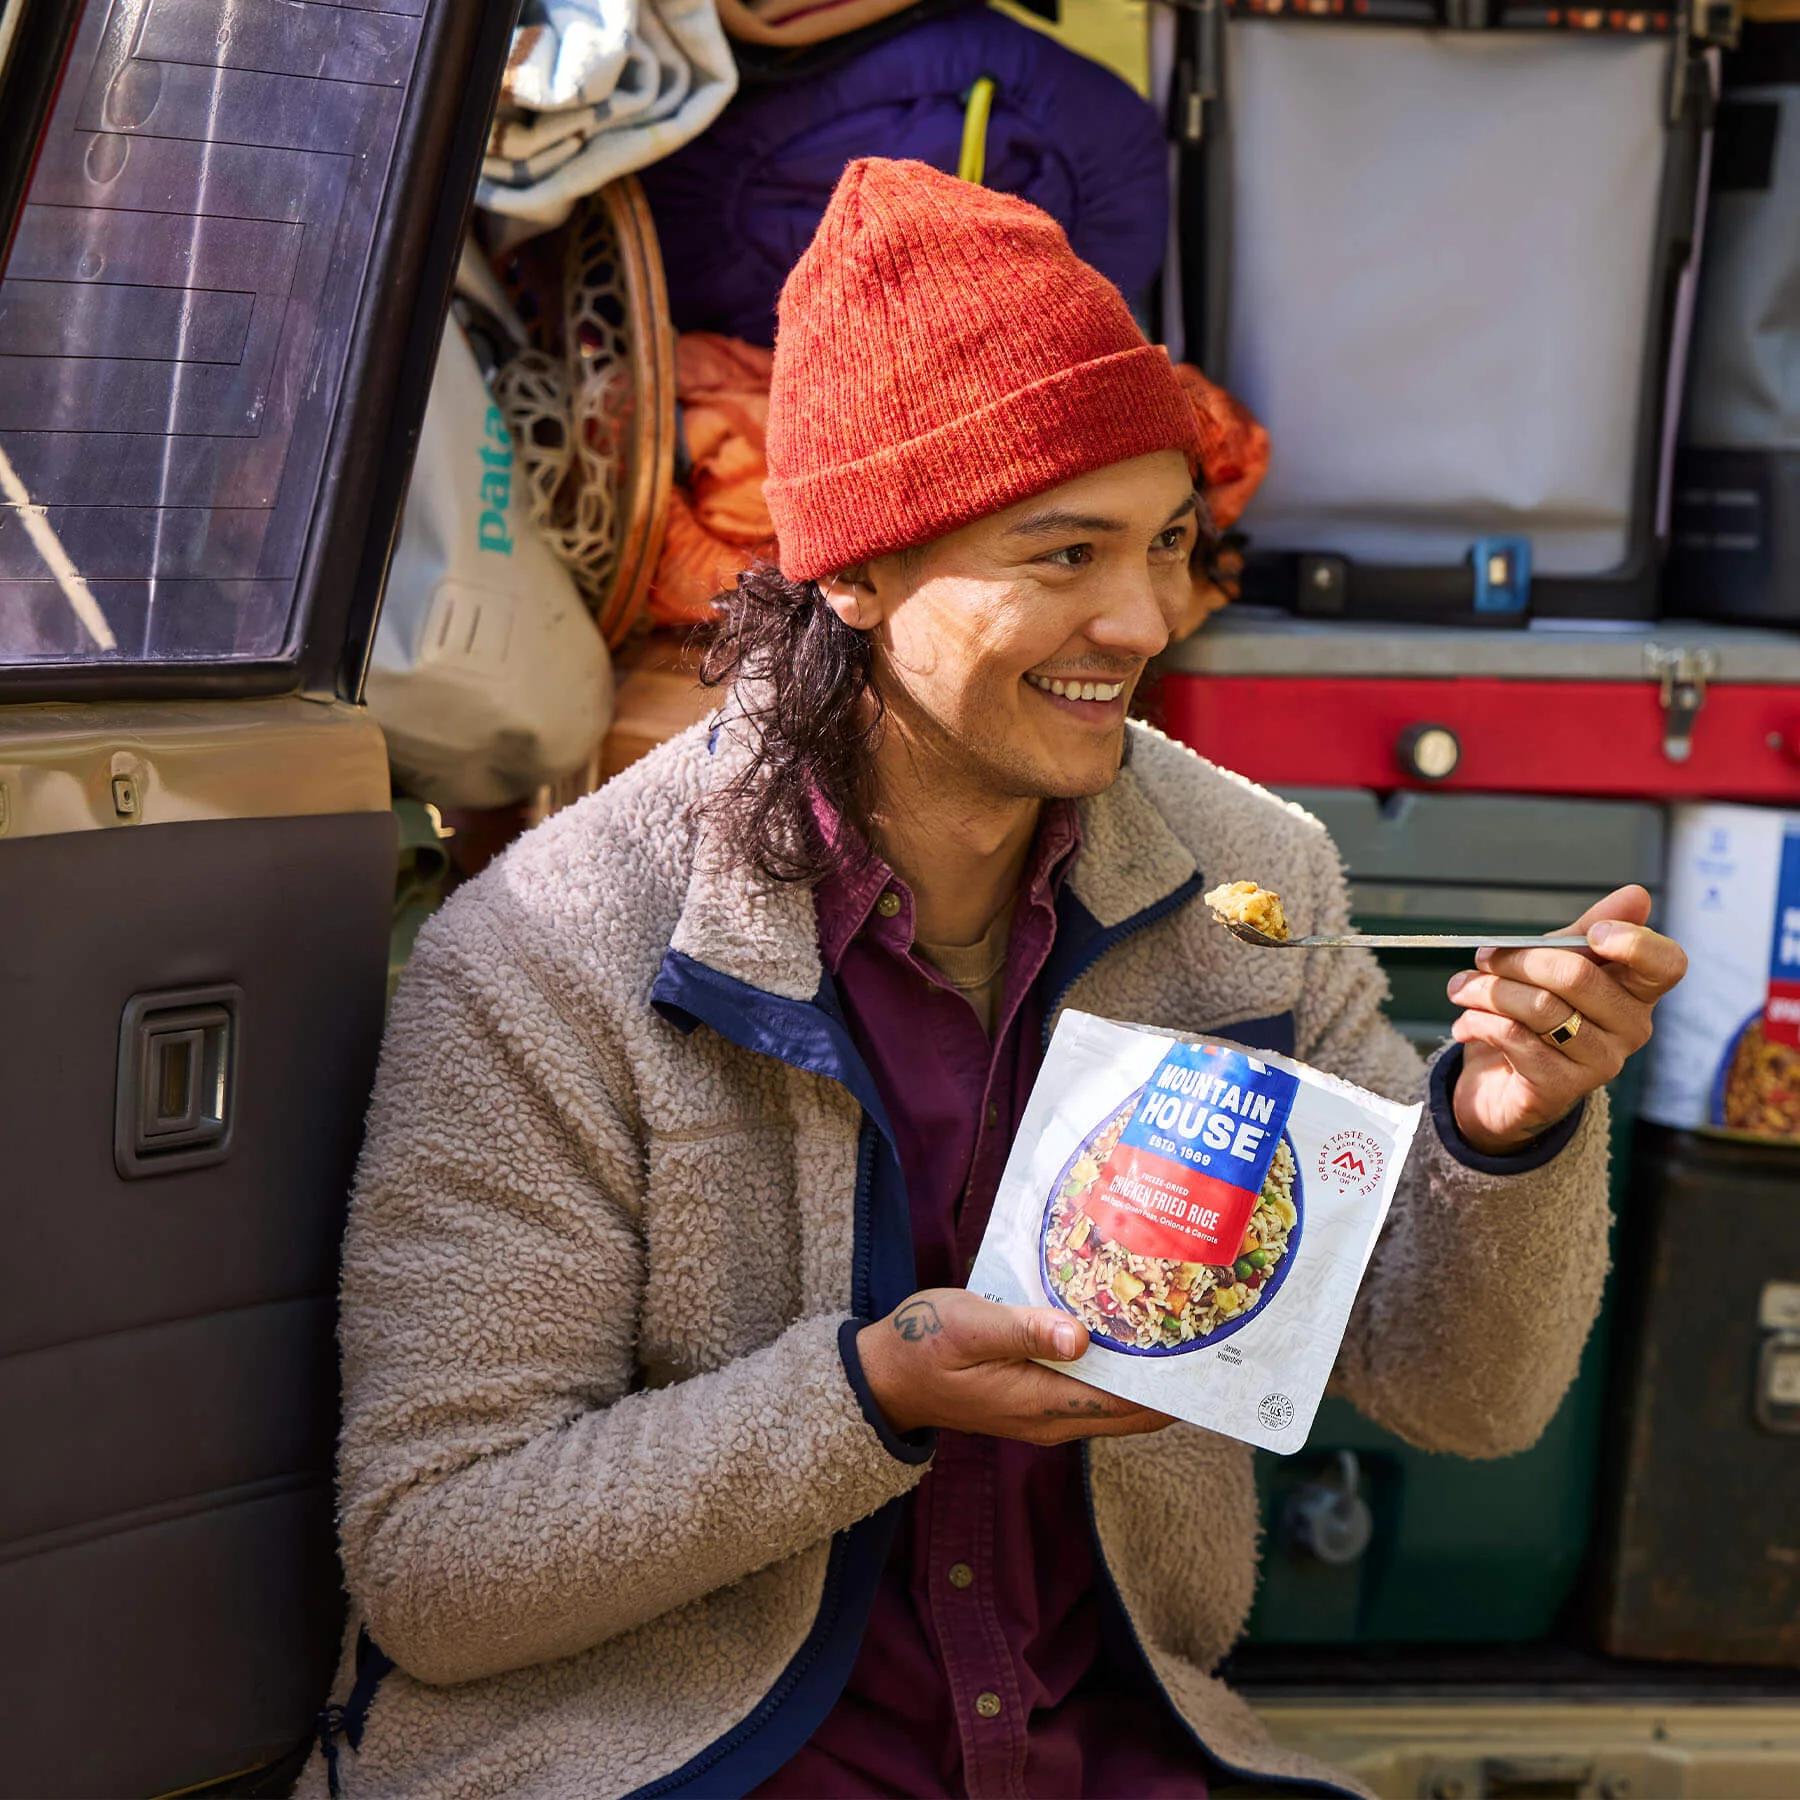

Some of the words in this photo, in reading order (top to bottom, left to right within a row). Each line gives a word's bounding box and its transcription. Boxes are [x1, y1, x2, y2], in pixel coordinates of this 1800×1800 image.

[1157, 1063, 1276, 1125] MOUNTAIN
[1138, 1092, 1265, 1163] HOUSE
[1148, 1134, 1177, 1154] ESTD.
[1180, 1146, 1211, 1167] 1969
[1336, 1141, 1355, 1151] MADE
[1318, 1143, 1330, 1182] GREAT
[1329, 1130, 1364, 1144] TASTE
[1359, 1137, 1384, 1196] GUARANTEE
[1332, 1168, 1361, 1182] ALBANY
[1141, 1172, 1190, 1196] FREEZE-DRIED
[1339, 1177, 1350, 1185] OR
[1109, 1175, 1153, 1208] CHICKEN
[1150, 1189, 1188, 1219] FRIED
[1187, 1203, 1220, 1231] RICE
[1159, 1216, 1185, 1232] Onions
[1184, 1225, 1191, 1234] &
[1191, 1229, 1219, 1244] Carrots
[1261, 1395, 1292, 1417] INSPECTED
